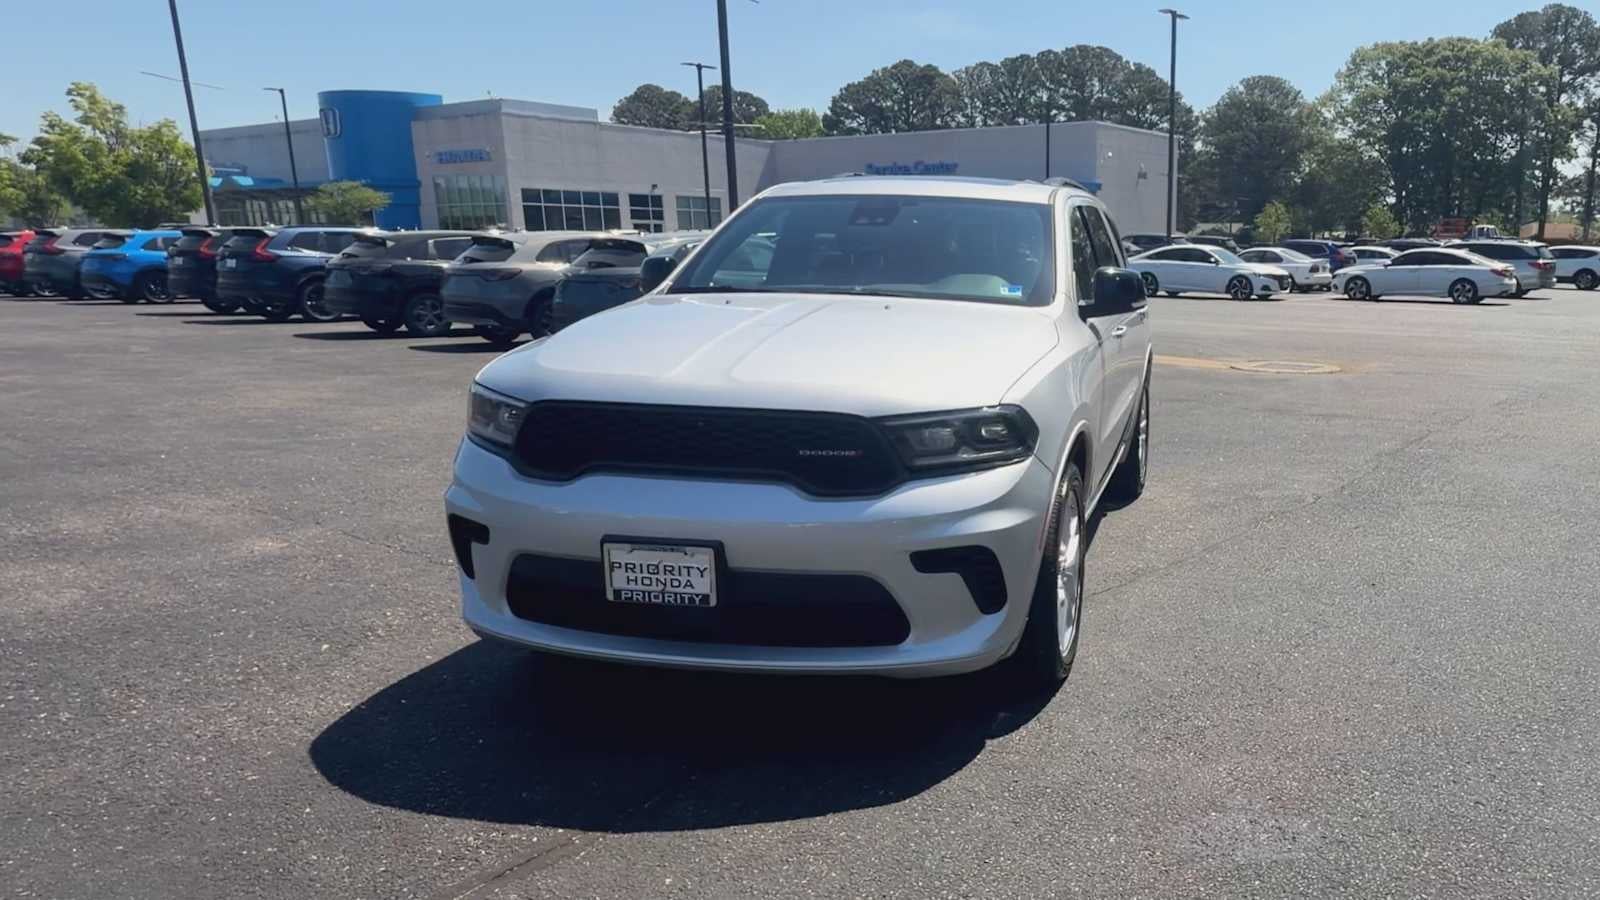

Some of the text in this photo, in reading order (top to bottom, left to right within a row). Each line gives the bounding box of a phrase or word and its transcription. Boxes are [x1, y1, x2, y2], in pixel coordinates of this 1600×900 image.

[611, 561, 708, 578] PRIORITY
[626, 575, 695, 589] HONDA
[621, 590, 703, 605] PRIORITY
